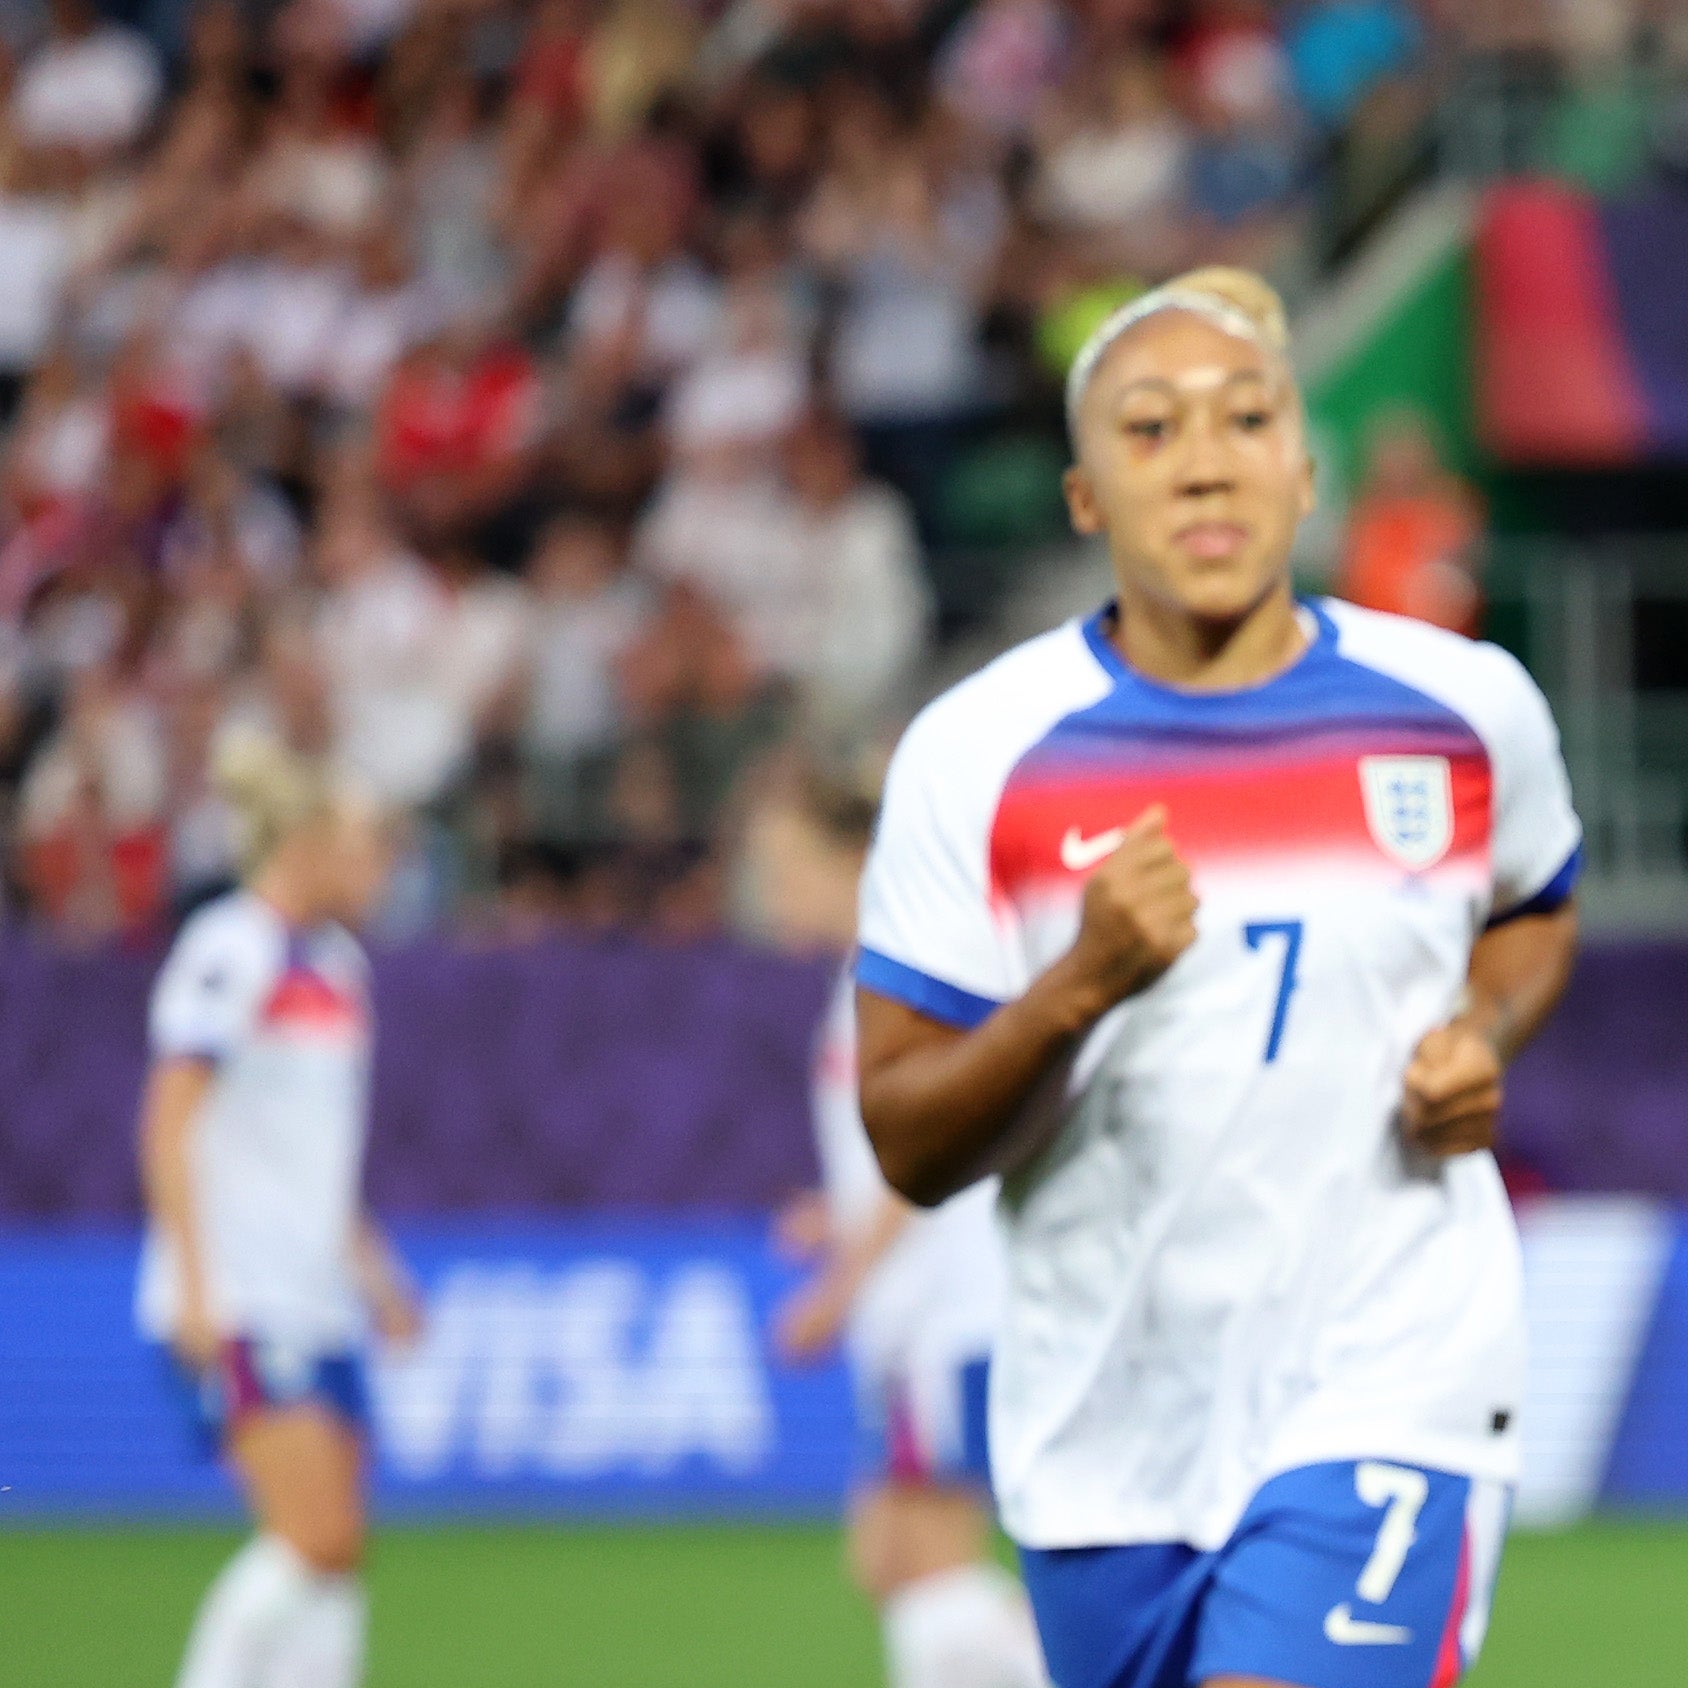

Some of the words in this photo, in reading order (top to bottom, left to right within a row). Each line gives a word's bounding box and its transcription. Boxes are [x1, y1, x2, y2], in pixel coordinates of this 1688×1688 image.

[1243, 918, 1306, 1065] 7
[370, 1258, 780, 1478] VISA
[1354, 1460, 1429, 1604] 7
